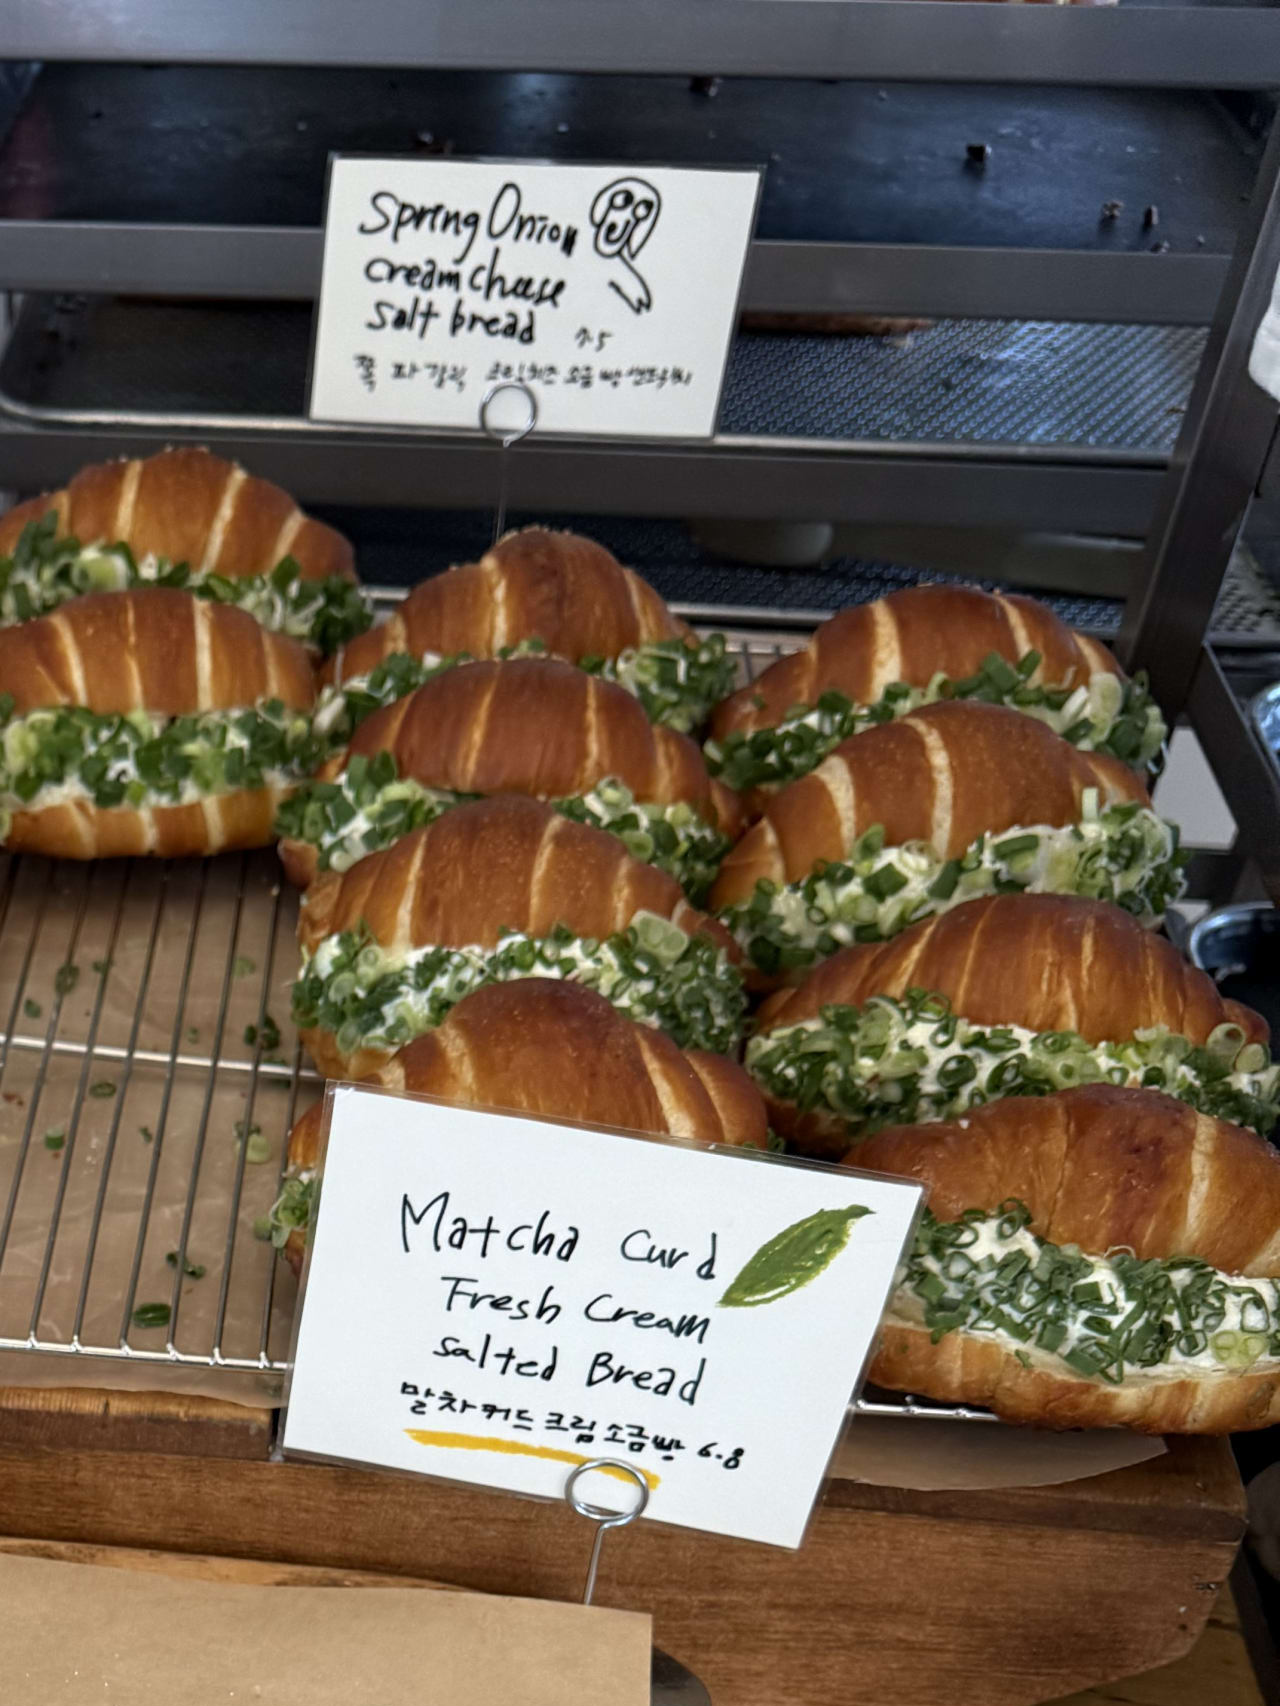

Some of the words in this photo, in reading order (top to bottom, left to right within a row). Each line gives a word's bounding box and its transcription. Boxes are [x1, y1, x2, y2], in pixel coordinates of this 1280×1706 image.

[358, 191, 480, 265] Spring
[486, 181, 578, 258] Onion
[449, 298, 535, 344] bread
[401, 1191, 579, 1262] Matcha
[620, 1229, 717, 1280] Curd
[440, 1276, 562, 1325] Fresh
[584, 1294, 711, 1344] Cream
[585, 1351, 708, 1406] Bread
[697, 1442, 746, 1471] 6.8
